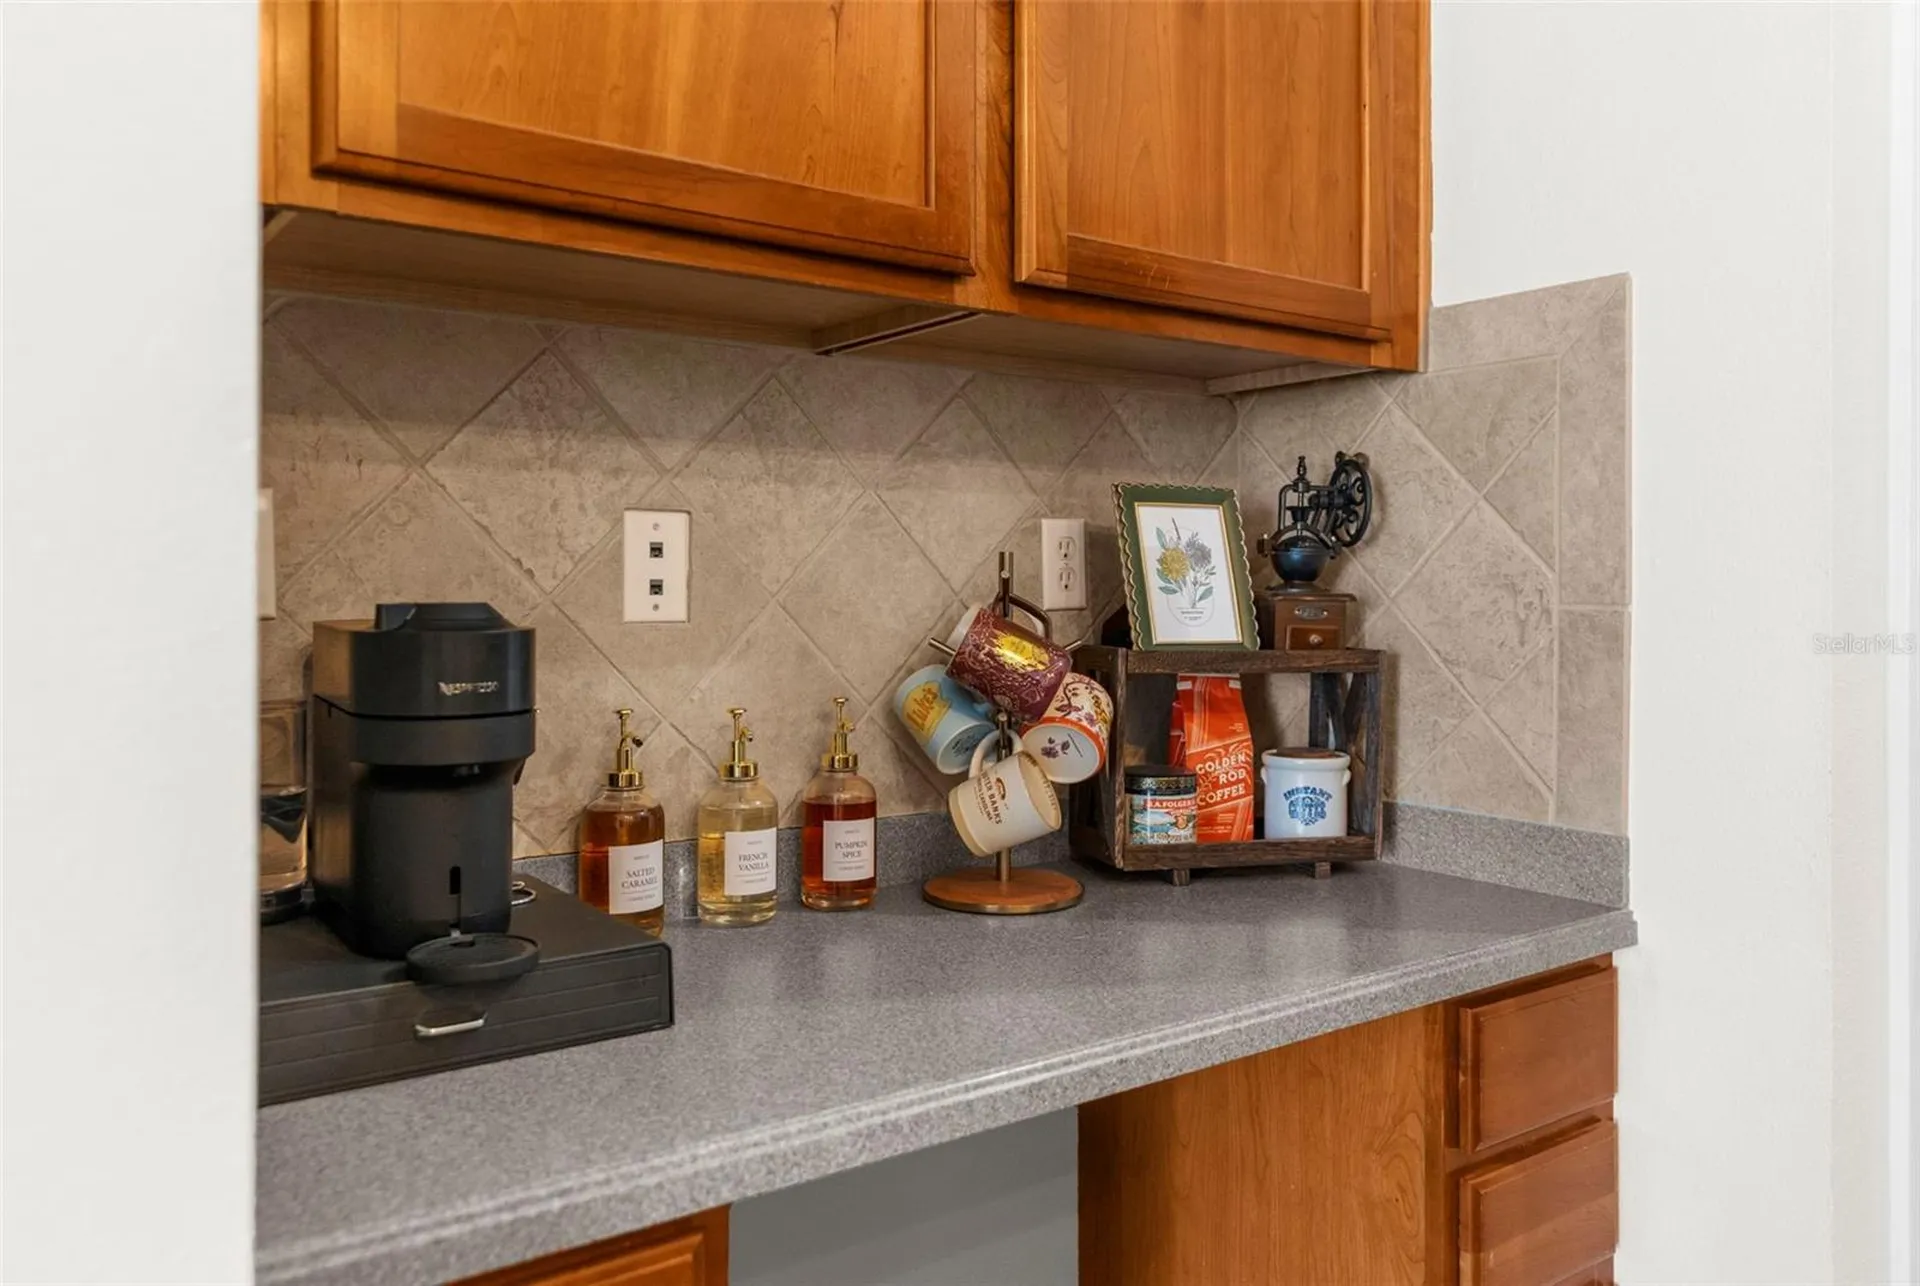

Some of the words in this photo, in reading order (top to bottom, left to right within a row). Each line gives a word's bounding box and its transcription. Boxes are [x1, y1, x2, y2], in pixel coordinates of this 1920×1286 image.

[1196, 751, 1246, 775] GOLDEN
[1219, 768, 1246, 785] ROD
[1197, 783, 1245, 806] COFFEE
[989, 793, 1003, 825] BANKS
[738, 851, 768, 861] FRENCH
[626, 867, 655, 878] SALTED
[738, 861, 769, 872] VANILLA
[621, 876, 658, 888] CARAMEL
